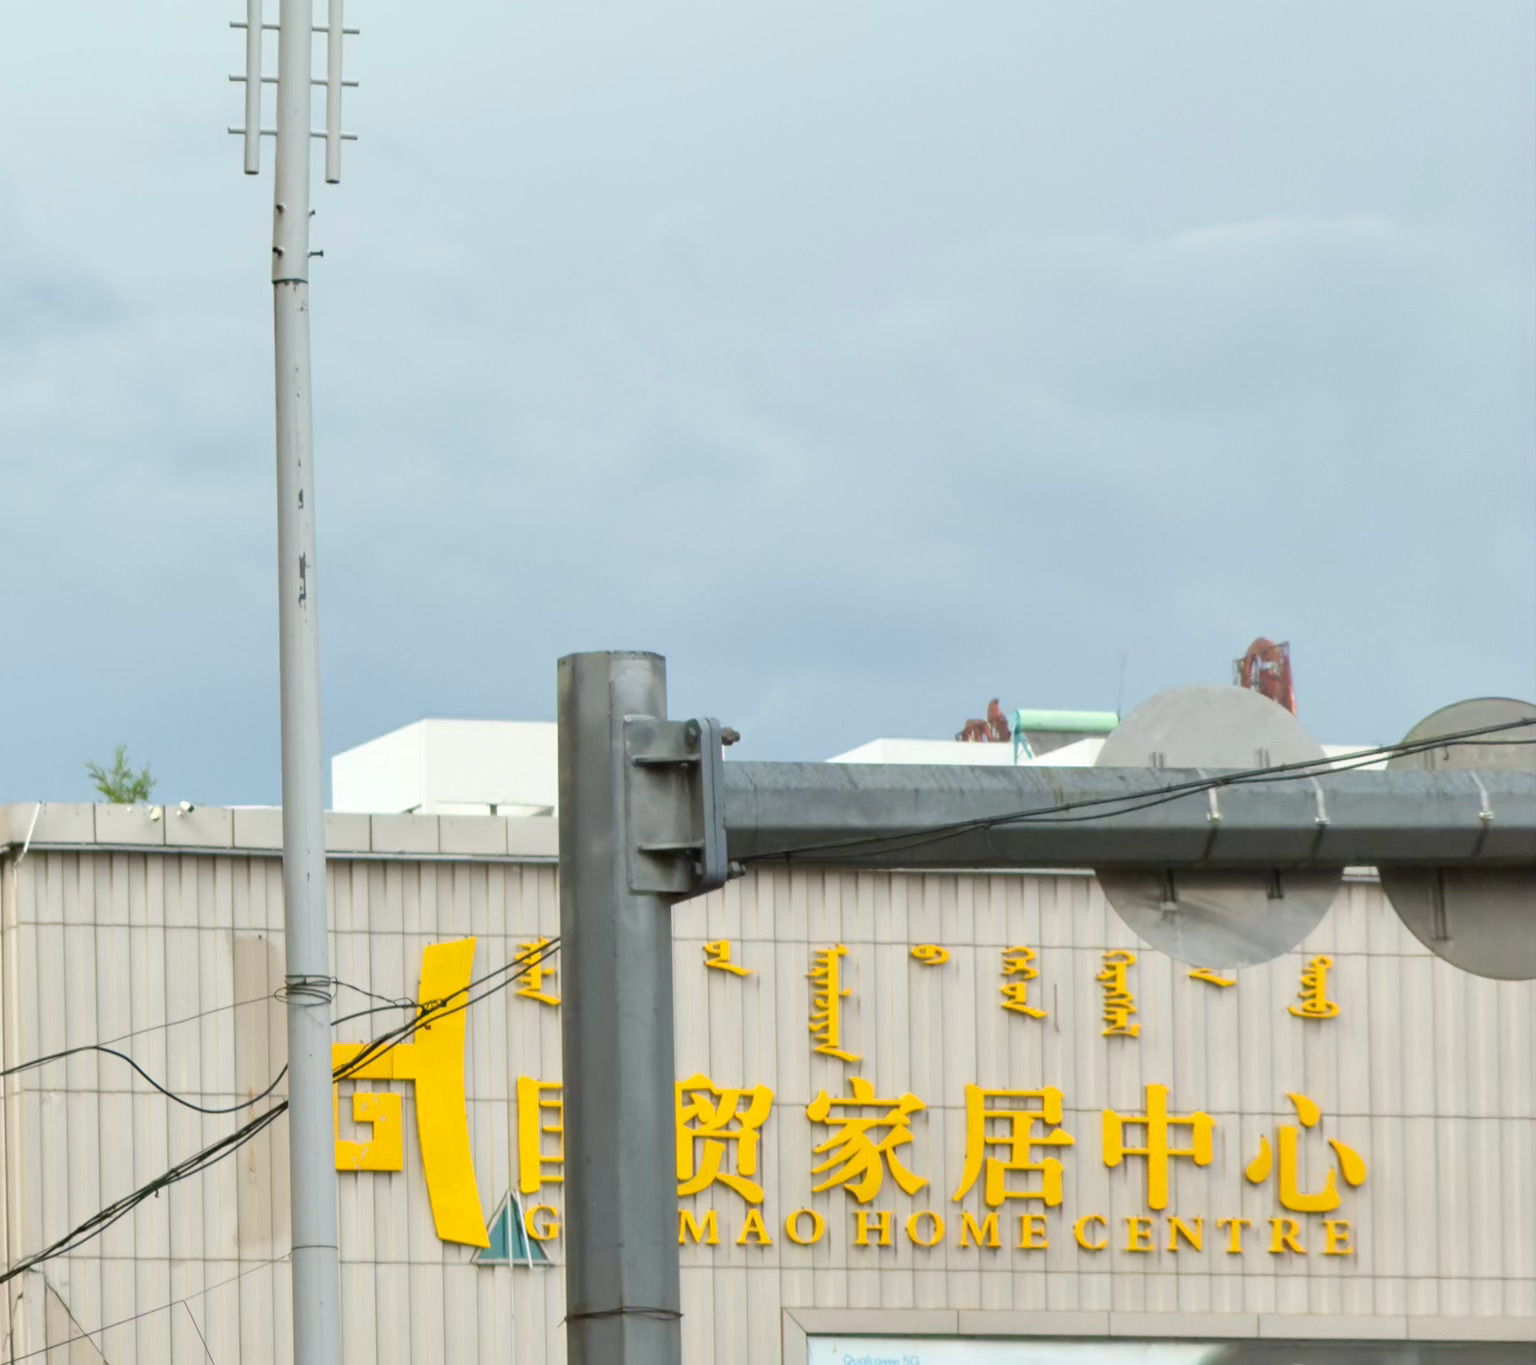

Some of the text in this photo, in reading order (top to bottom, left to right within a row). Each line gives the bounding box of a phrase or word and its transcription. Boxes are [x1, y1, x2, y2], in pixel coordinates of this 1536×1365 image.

[524, 1204, 1354, 1256] GMAO HOME CENTRE
